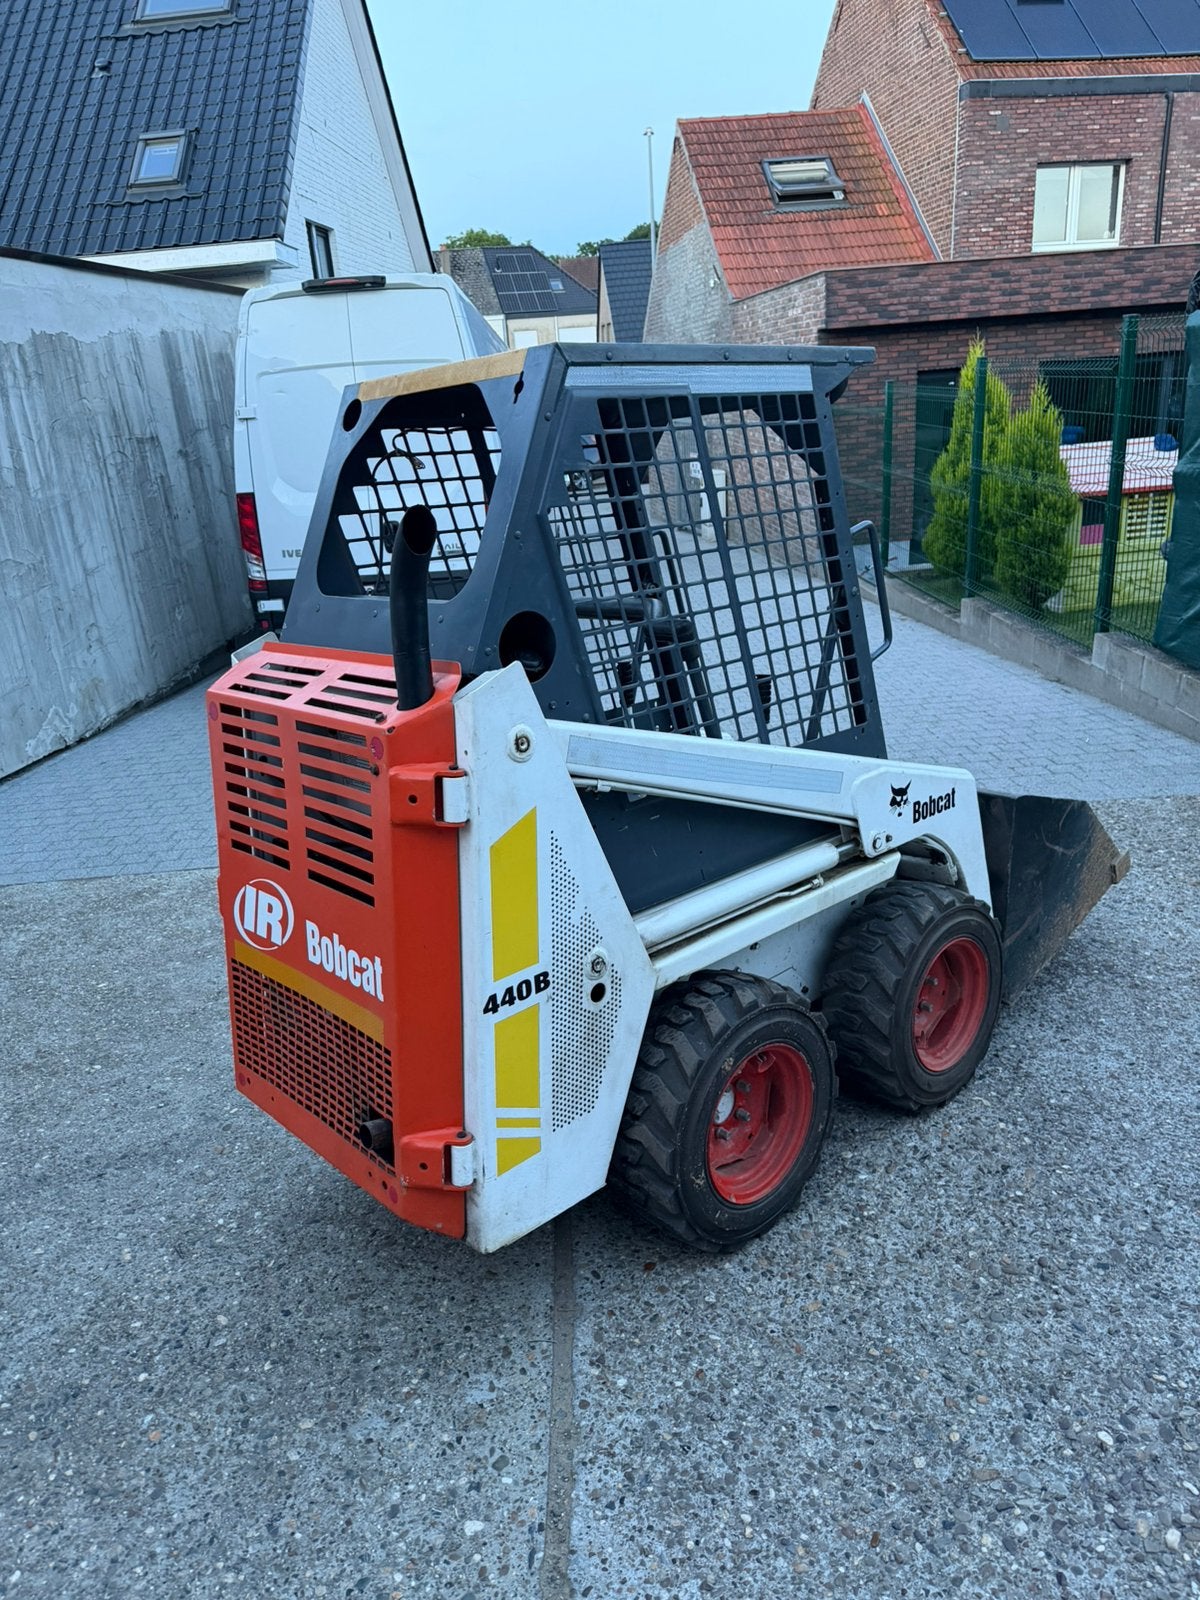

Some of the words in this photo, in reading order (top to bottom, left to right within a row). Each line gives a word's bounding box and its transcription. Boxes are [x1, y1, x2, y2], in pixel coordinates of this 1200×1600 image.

[281, 549, 302, 558] IVE
[913, 787, 956, 824] Bobcat
[243, 884, 283, 946] IR
[306, 919, 384, 1002] Bobcat
[482, 970, 551, 1015] 440B
